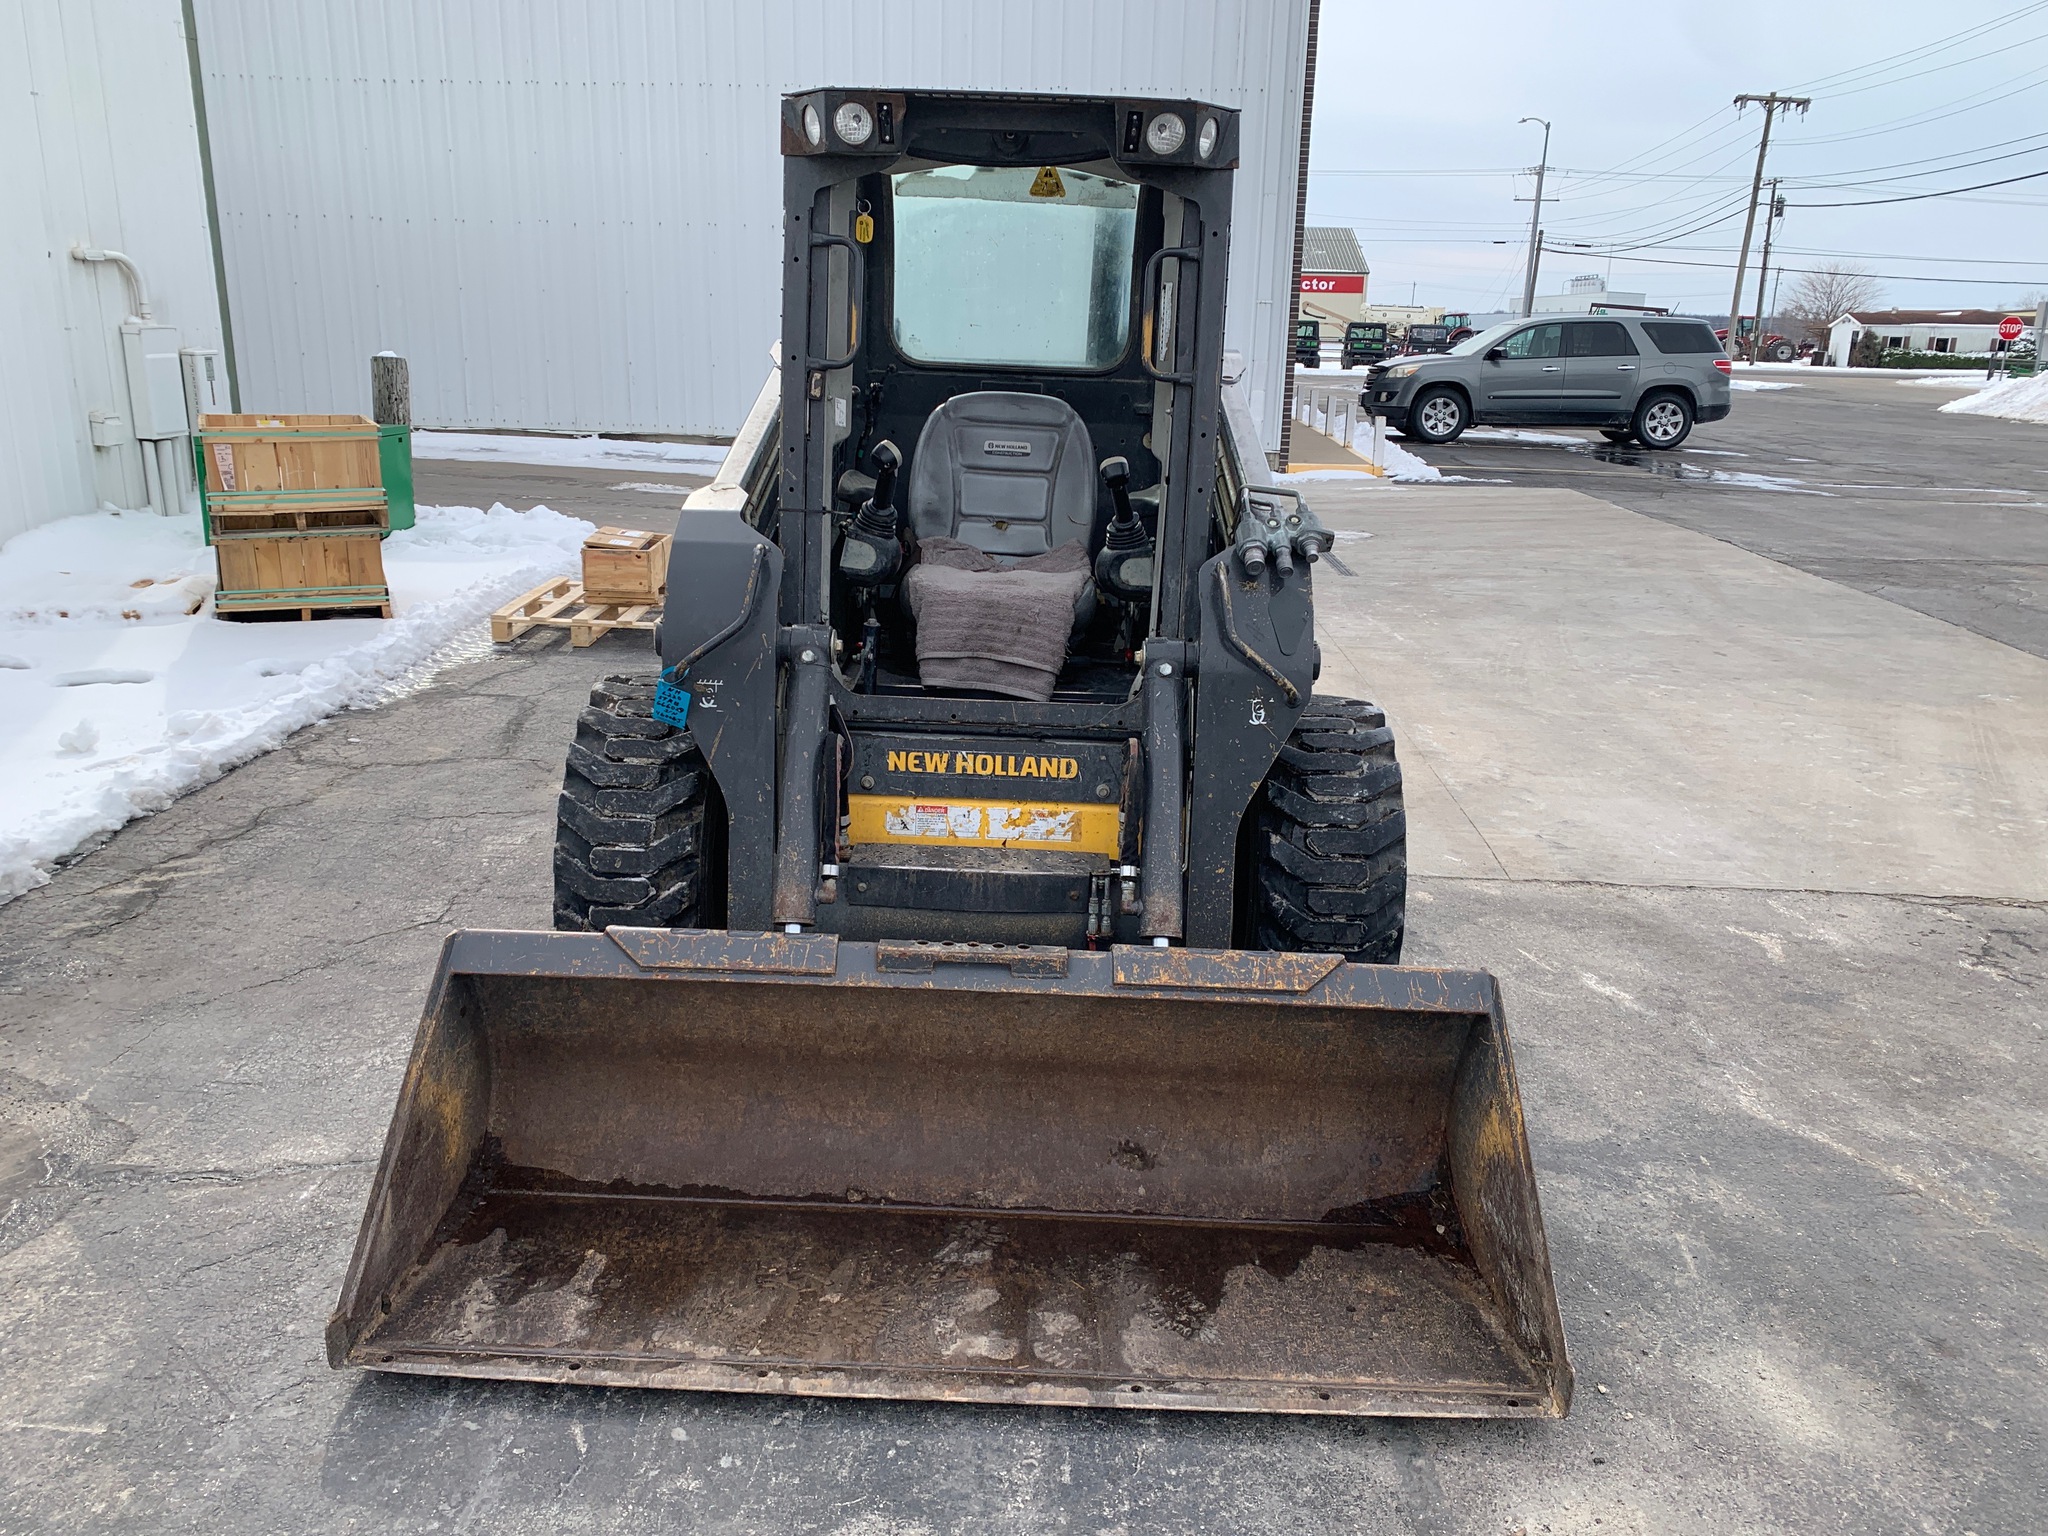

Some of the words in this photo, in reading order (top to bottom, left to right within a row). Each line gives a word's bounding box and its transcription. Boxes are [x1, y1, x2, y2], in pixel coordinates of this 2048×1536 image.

[1302, 278, 1336, 291] ctor
[2000, 323, 2022, 333] STOP
[888, 751, 949, 774] NEW
[955, 753, 1079, 780] HOLLAND
